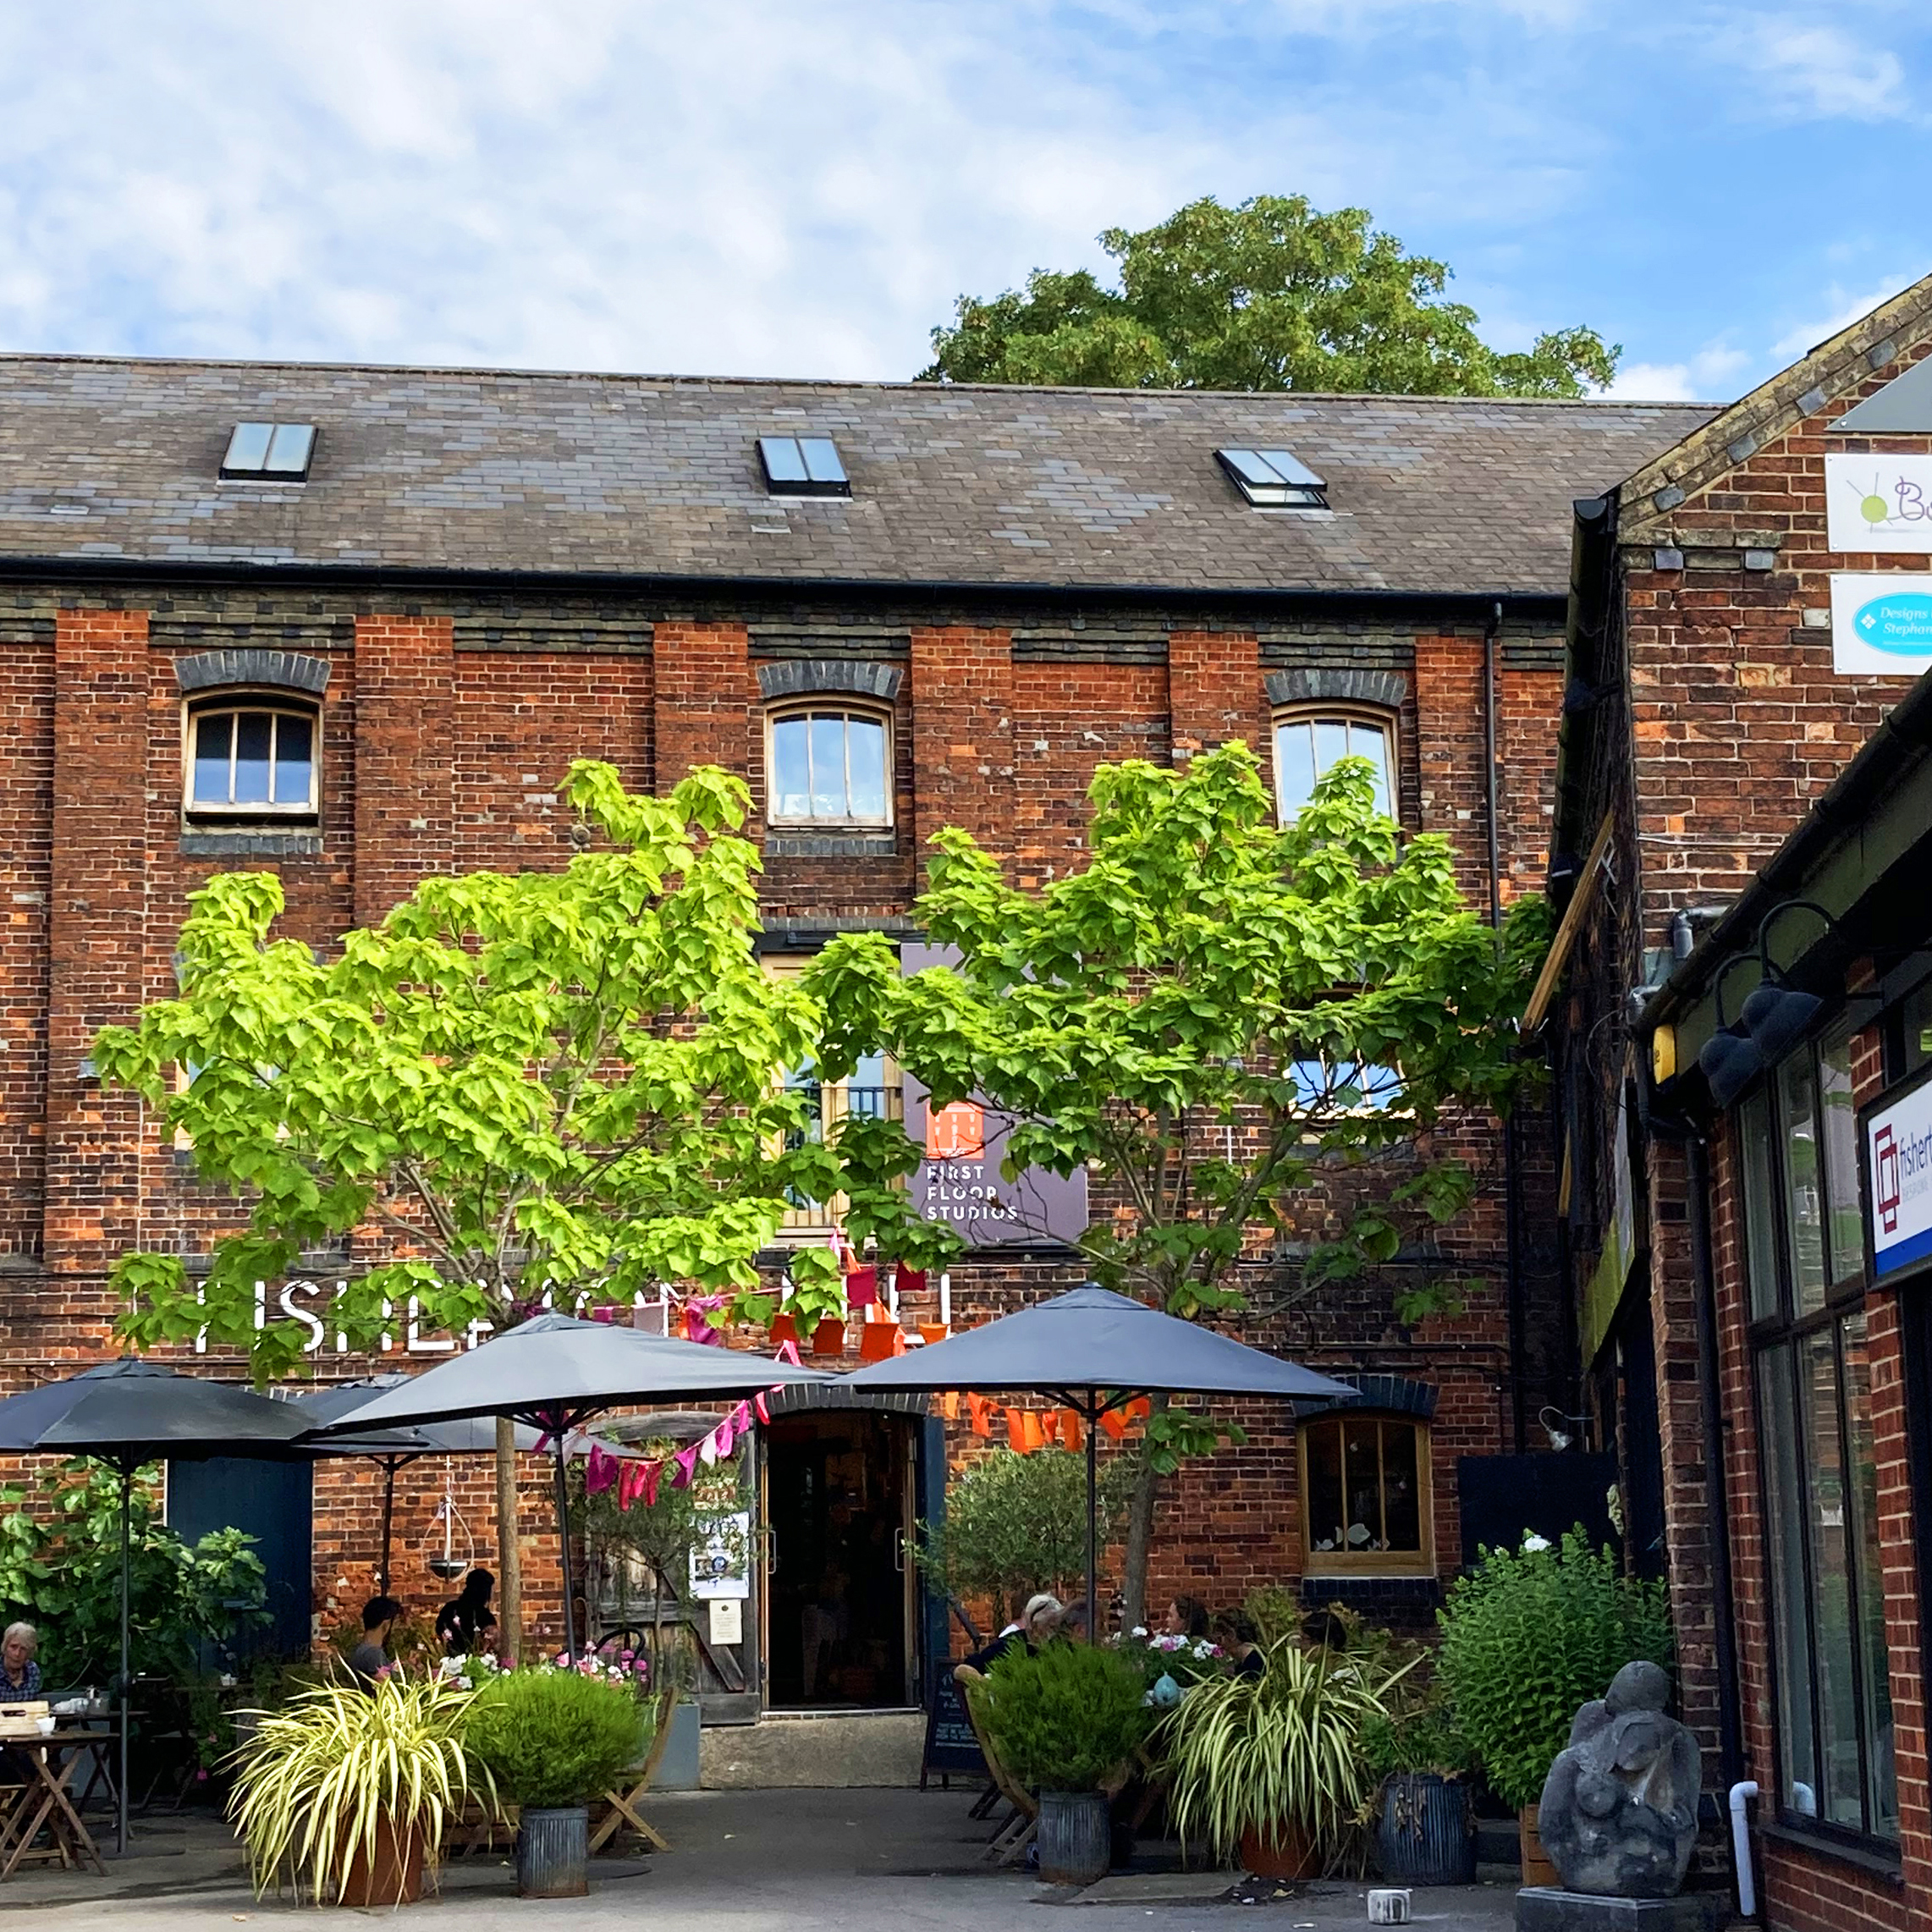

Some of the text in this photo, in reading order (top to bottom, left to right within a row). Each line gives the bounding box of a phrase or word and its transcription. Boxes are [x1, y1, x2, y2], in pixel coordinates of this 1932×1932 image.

[1880, 607, 1928, 621] Designs
[927, 1165, 984, 1180] FIRST
[927, 1186, 997, 1201] FLOOR
[927, 1206, 1018, 1220] STUDIOS
